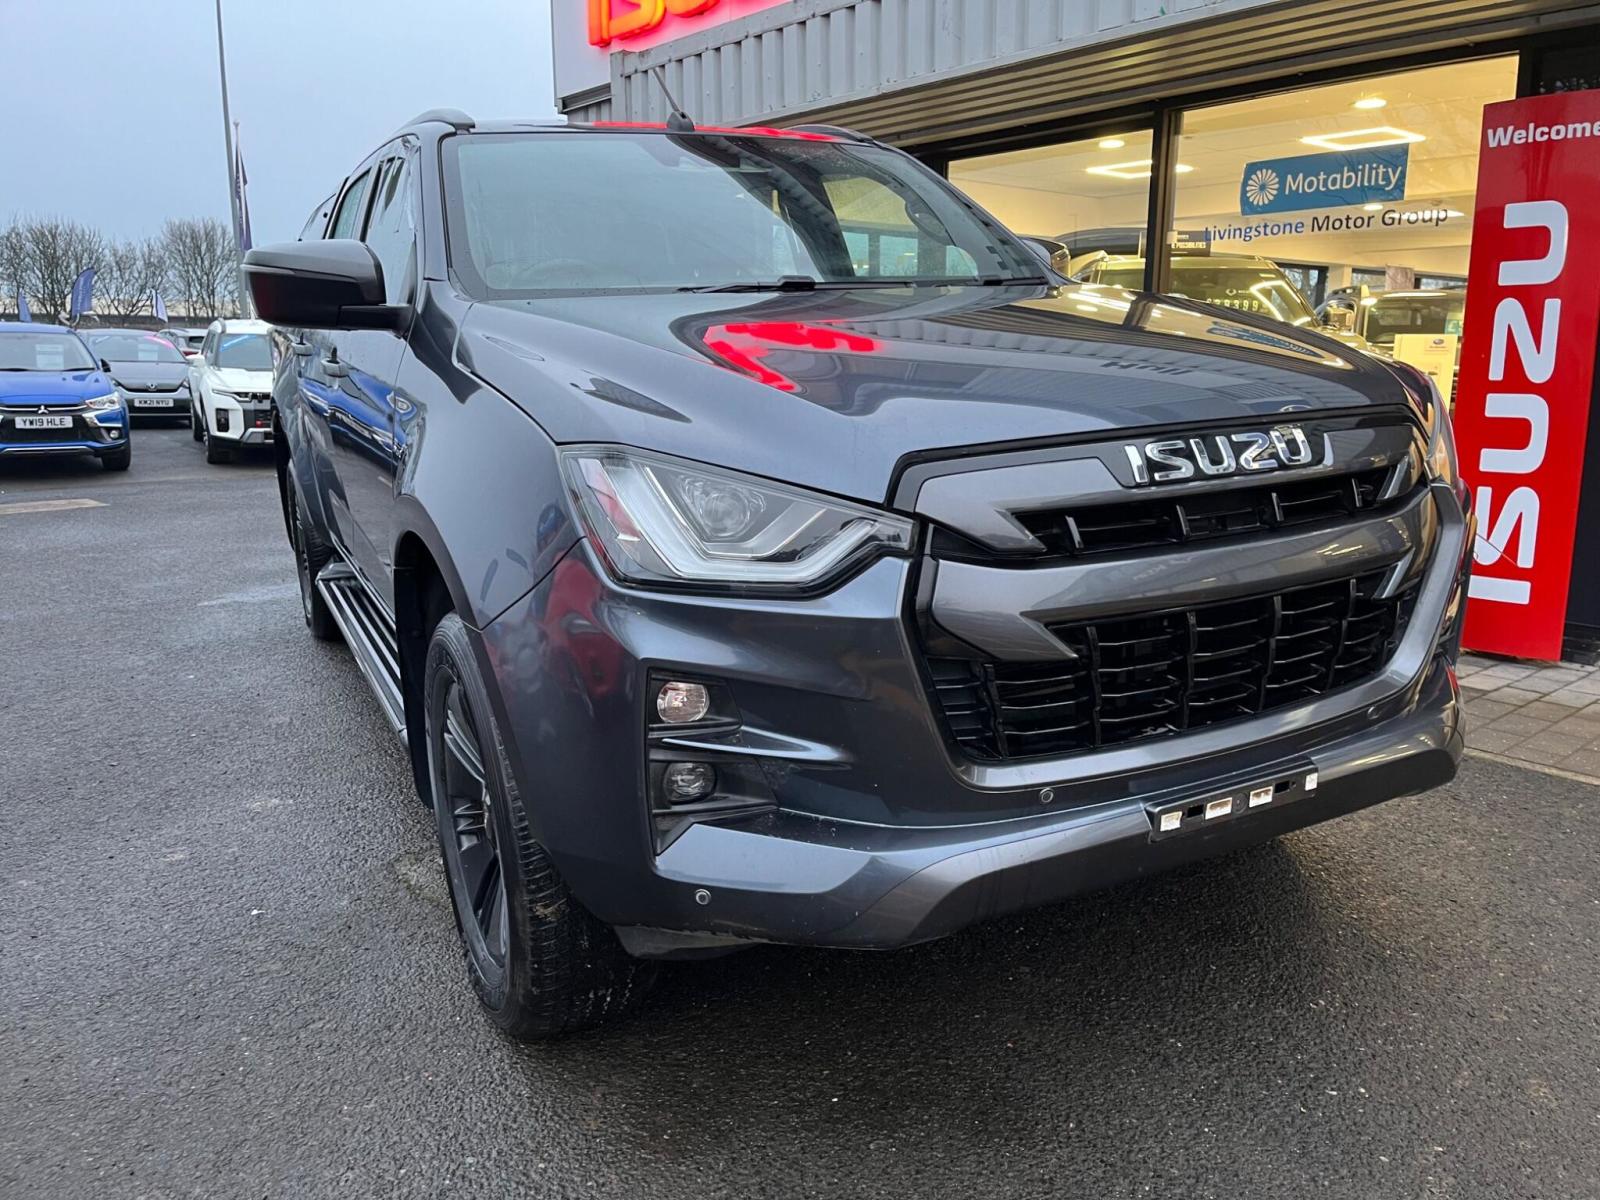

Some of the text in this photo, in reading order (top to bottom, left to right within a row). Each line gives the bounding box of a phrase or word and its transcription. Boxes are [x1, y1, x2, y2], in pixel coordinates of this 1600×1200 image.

[1487, 121, 1600, 149] Welcome
[1285, 163, 1402, 195] Motability
[1204, 208, 1448, 242] Livingstone Motor Group
[1467, 199, 1569, 605] ISUZU
[21, 416, 66, 428] YW19 HLE
[1124, 424, 1313, 484] ISUZU
